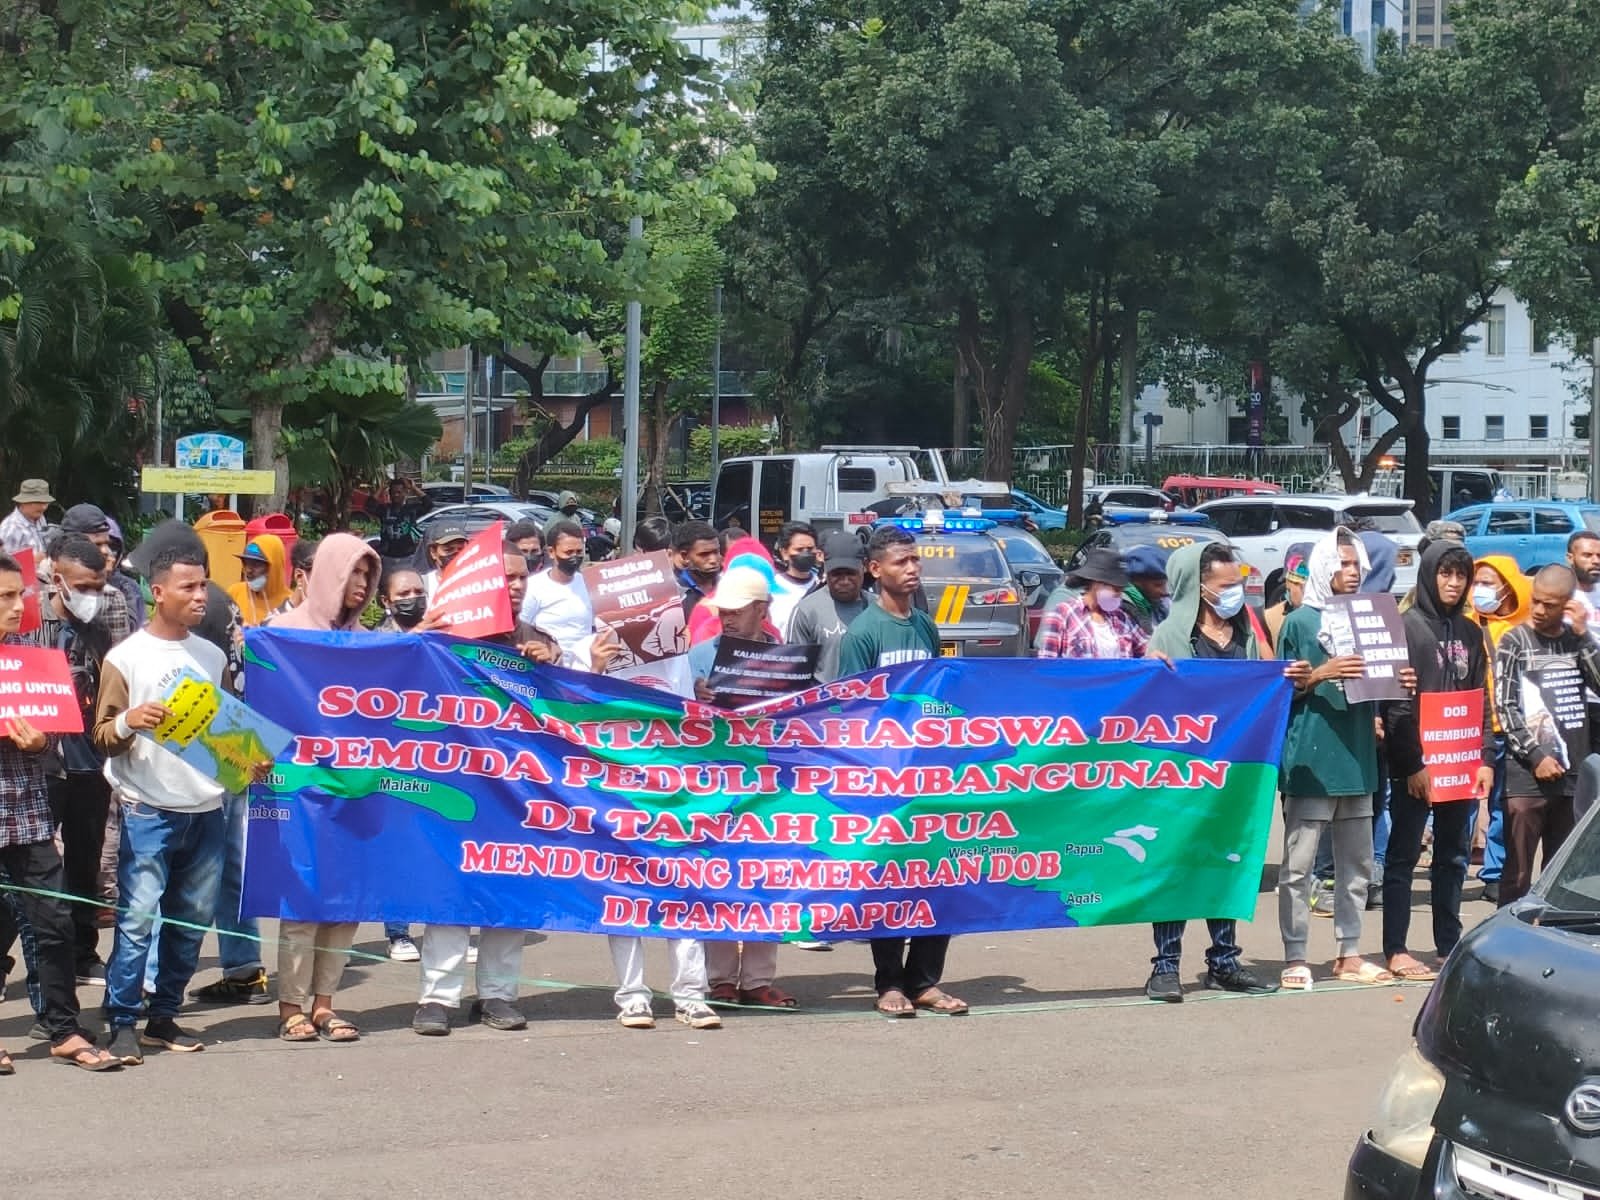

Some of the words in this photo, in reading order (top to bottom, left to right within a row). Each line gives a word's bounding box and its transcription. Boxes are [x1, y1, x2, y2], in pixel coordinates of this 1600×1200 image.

[917, 545, 954, 559] 1011
[477, 649, 527, 672] Weigeo
[733, 650, 760, 660] KALAU
[25, 682, 72, 695] UNTUK
[19, 705, 58, 717] MAJU
[922, 702, 953, 716] Biak
[1443, 705, 1469, 719] DOB
[317, 685, 715, 750] SOLIDARITAS
[725, 714, 1089, 749] MAHASISWA
[1097, 713, 1218, 745] DAN
[1423, 726, 1481, 743] MEMBUKA
[1421, 748, 1481, 766] LAPANGAN
[291, 735, 552, 784] PEMUDA
[563, 755, 782, 798] PEDULI
[791, 759, 1231, 798] PEMBANGUNAN
[378, 776, 431, 794] Malaku
[1433, 773, 1471, 788] KERJA
[521, 799, 598, 835] DI
[606, 808, 820, 844] TANAH
[831, 809, 1017, 846] PAPUA
[949, 846, 977, 860] West
[1065, 843, 1103, 859] Papua
[460, 839, 732, 890] MENDUKUNG
[737, 856, 983, 891] PEMEKARAN
[987, 851, 1062, 883] DOB
[601, 895, 651, 928] DI
[657, 900, 802, 933] TANAH
[809, 898, 937, 933] PAPUA
